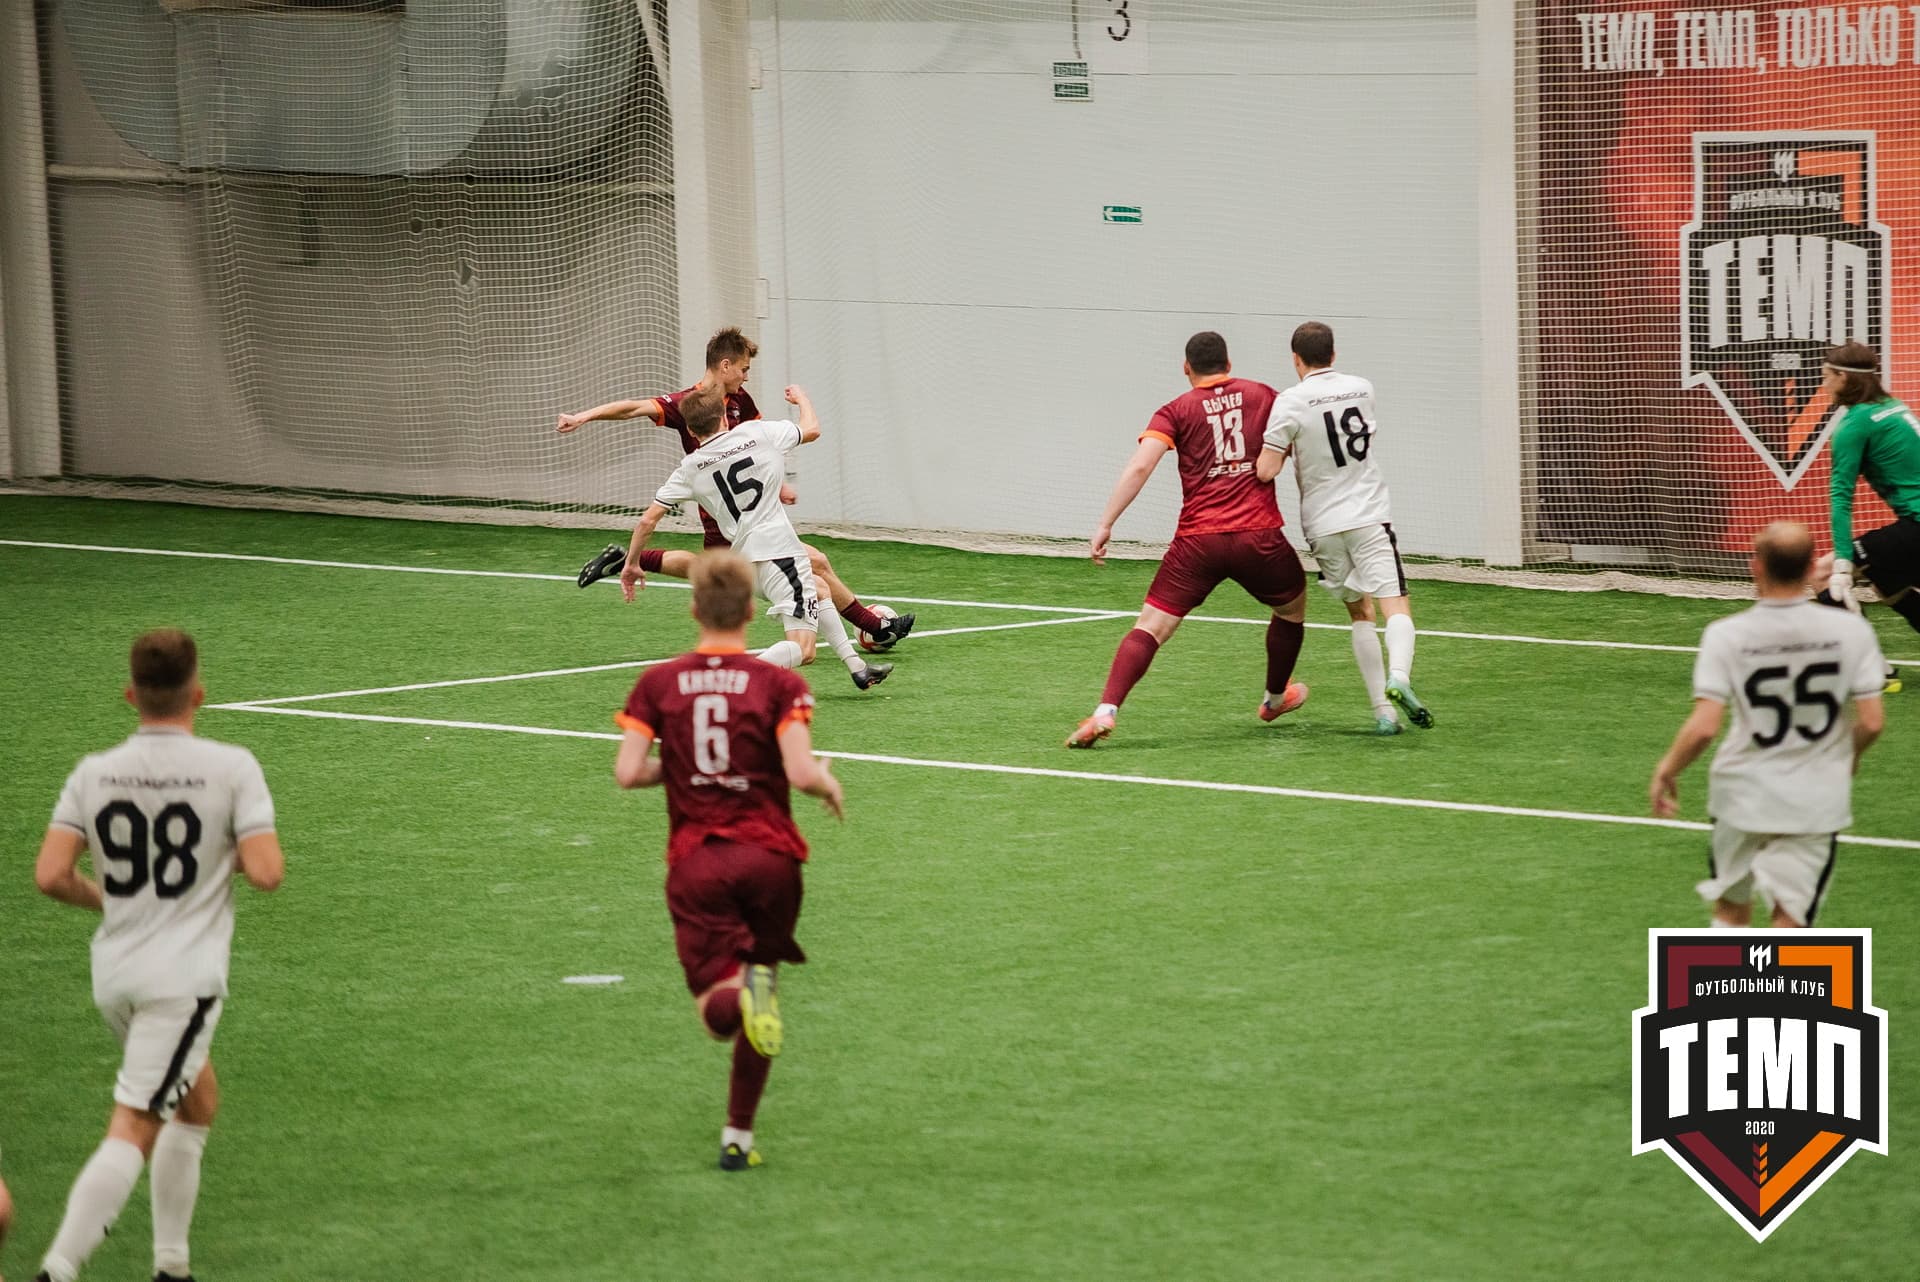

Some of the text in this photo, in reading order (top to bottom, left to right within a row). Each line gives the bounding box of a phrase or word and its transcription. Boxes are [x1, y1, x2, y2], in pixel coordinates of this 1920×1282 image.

[1107, 0, 1131, 42] 3
[1577, 12, 1664, 77] ТЕМП,
[1674, 9, 1766, 75] ТЕМП,
[1775, 5, 1899, 68] ТОЛЬКО
[1702, 233, 1868, 349] ТЕМП
[1207, 408, 1246, 464] 13
[1323, 406, 1370, 468] 18
[712, 455, 764, 524] 15
[693, 694, 730, 774] 6
[1744, 661, 1840, 748] 55
[95, 800, 202, 899] 98
